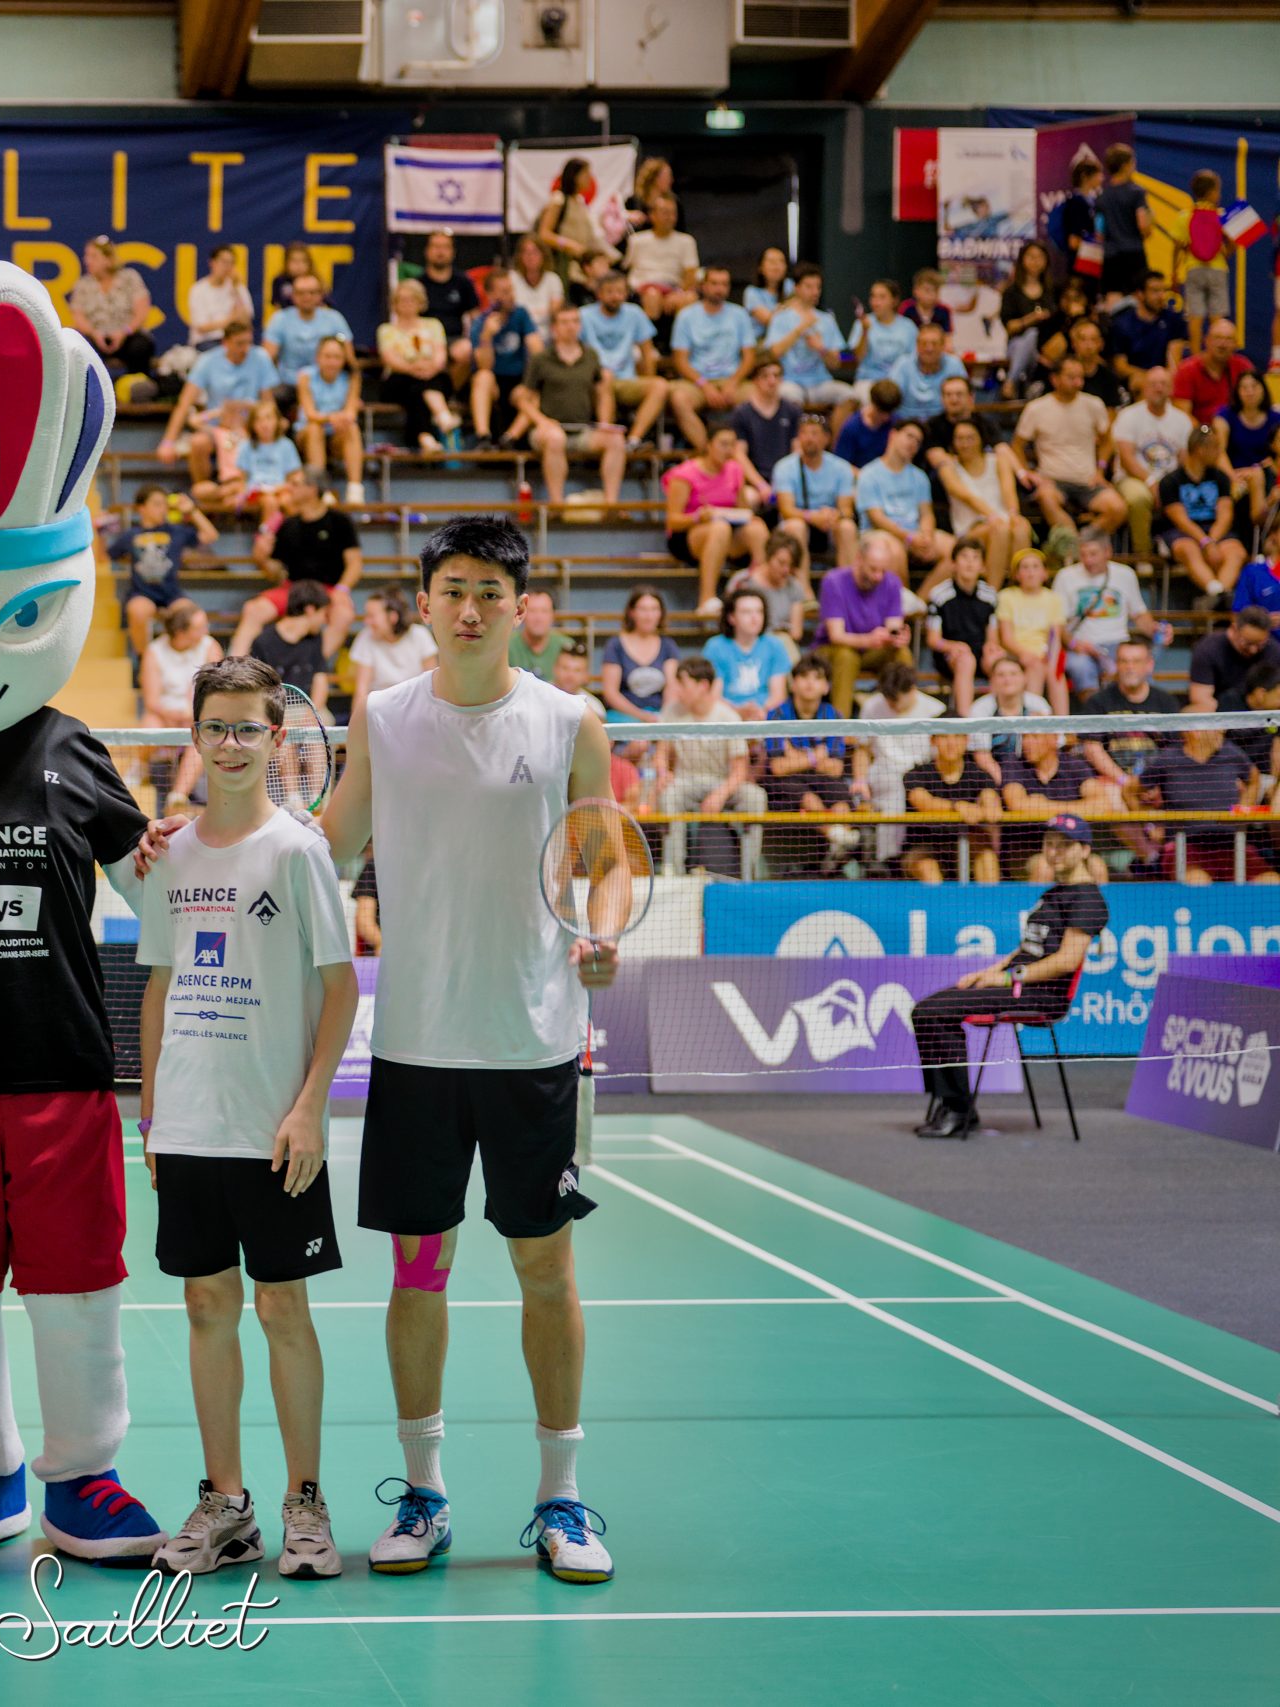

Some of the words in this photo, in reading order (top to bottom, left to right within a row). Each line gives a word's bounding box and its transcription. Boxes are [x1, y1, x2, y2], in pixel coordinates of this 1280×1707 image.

[167, 887, 237, 904] VALENCE
[182, 905, 236, 913] INTERNATIONAL
[194, 949, 220, 964] AXA
[177, 974, 218, 987] AGENCE
[220, 975, 252, 990] RPM
[225, 996, 261, 1006] MEJEAN
[1161, 1014, 1244, 1065] SPORTS
